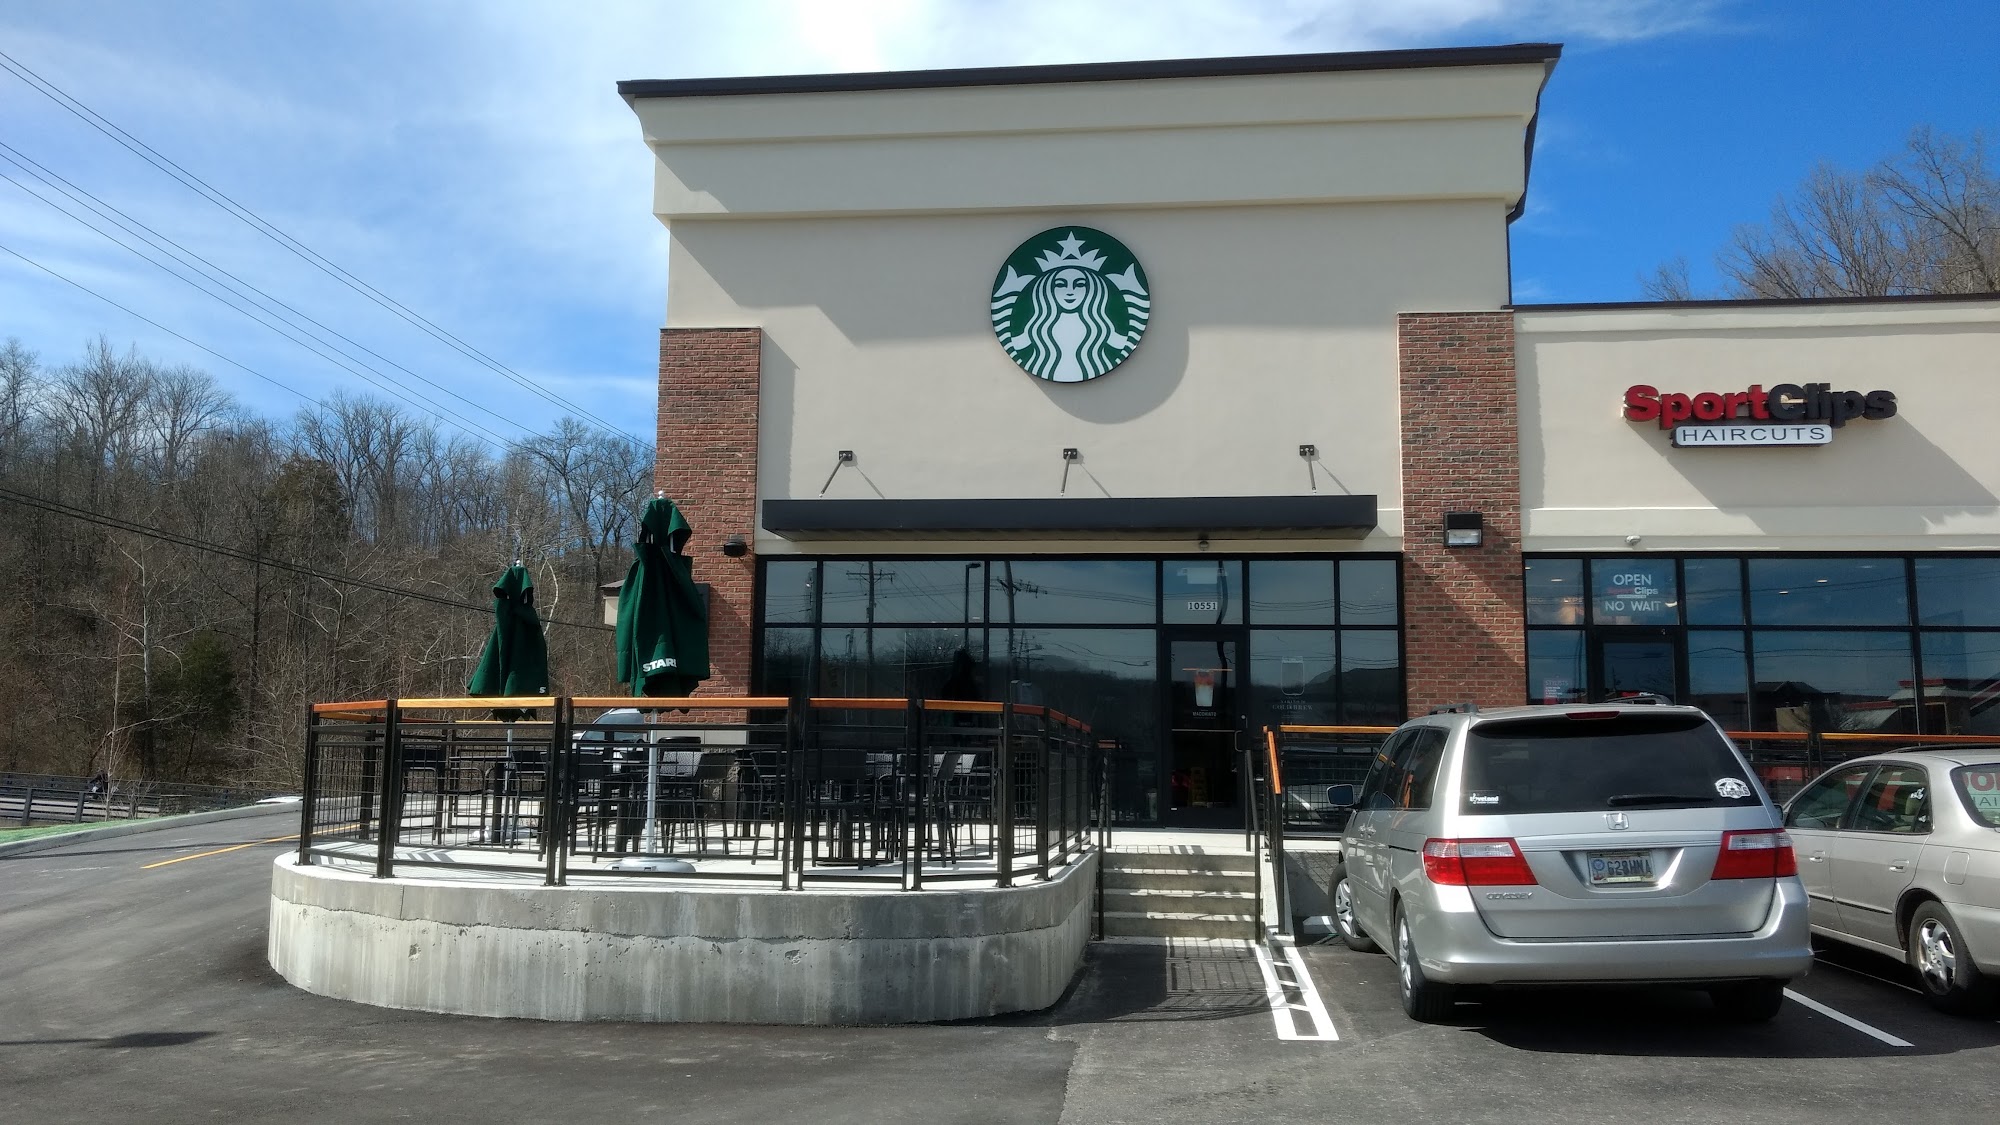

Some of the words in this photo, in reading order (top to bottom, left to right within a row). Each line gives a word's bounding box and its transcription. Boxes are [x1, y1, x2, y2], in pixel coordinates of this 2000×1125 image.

[1682, 427, 1825, 441] HAIRCUTS
[1613, 574, 1652, 586] OPEN
[1189, 602, 1217, 610] 10551
[1605, 601, 1625, 611] NO
[1631, 601, 1661, 611] WAIT
[643, 658, 677, 672] STAR
